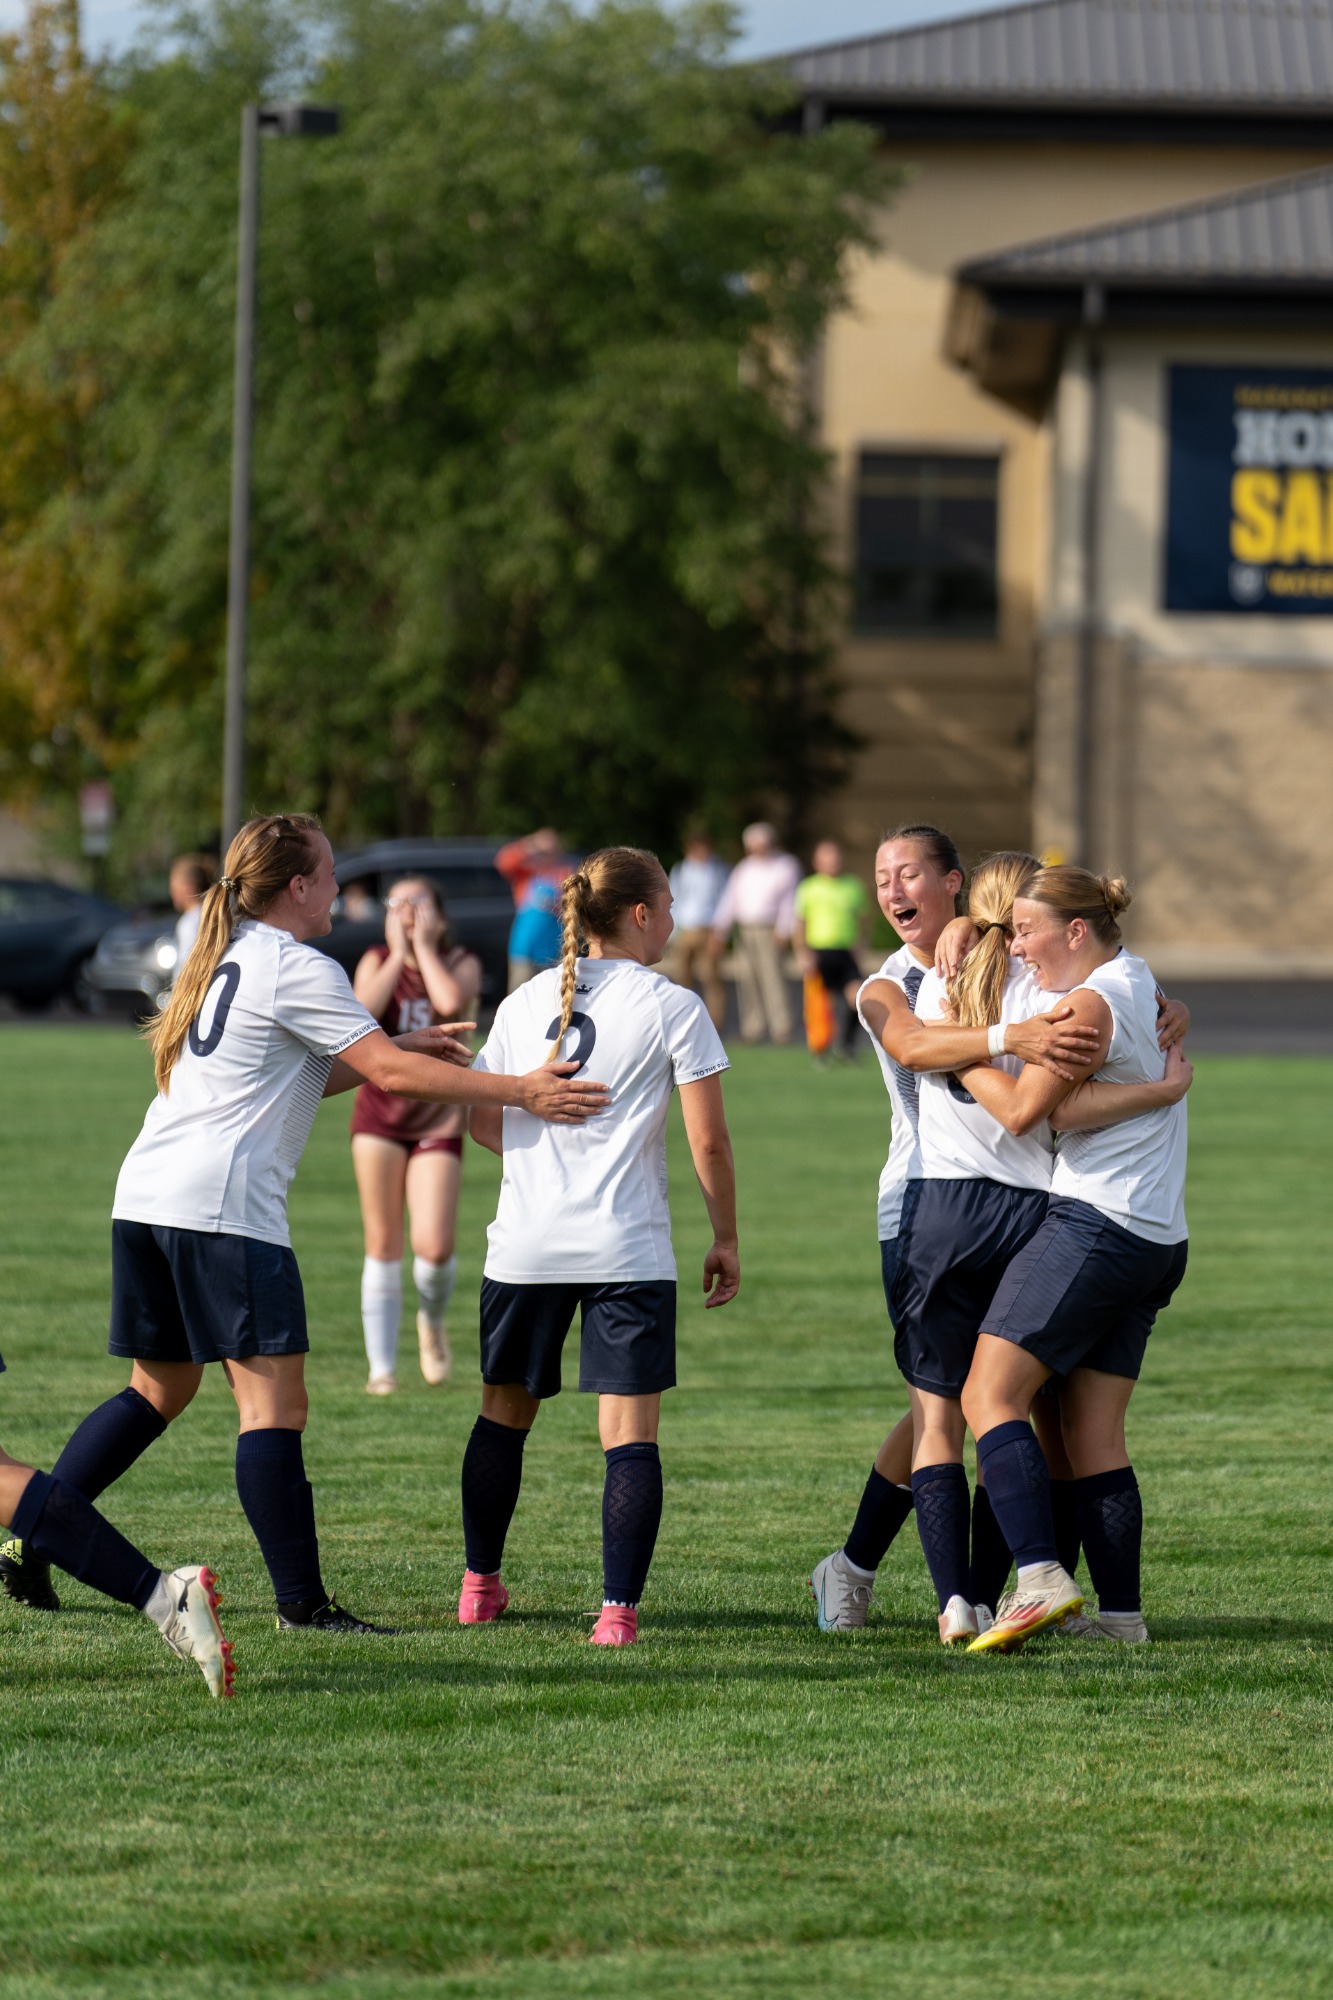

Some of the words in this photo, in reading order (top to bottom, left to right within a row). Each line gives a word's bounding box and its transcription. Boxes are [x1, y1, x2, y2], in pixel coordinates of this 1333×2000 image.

[1232, 410, 1333, 466] HO
[1231, 470, 1333, 563] SA
[189, 962, 240, 1057] 0
[398, 997, 430, 1032] 15
[339, 1038, 351, 1048] THE
[350, 1024, 371, 1040] PRAISE
[705, 1065, 717, 1074] THE
